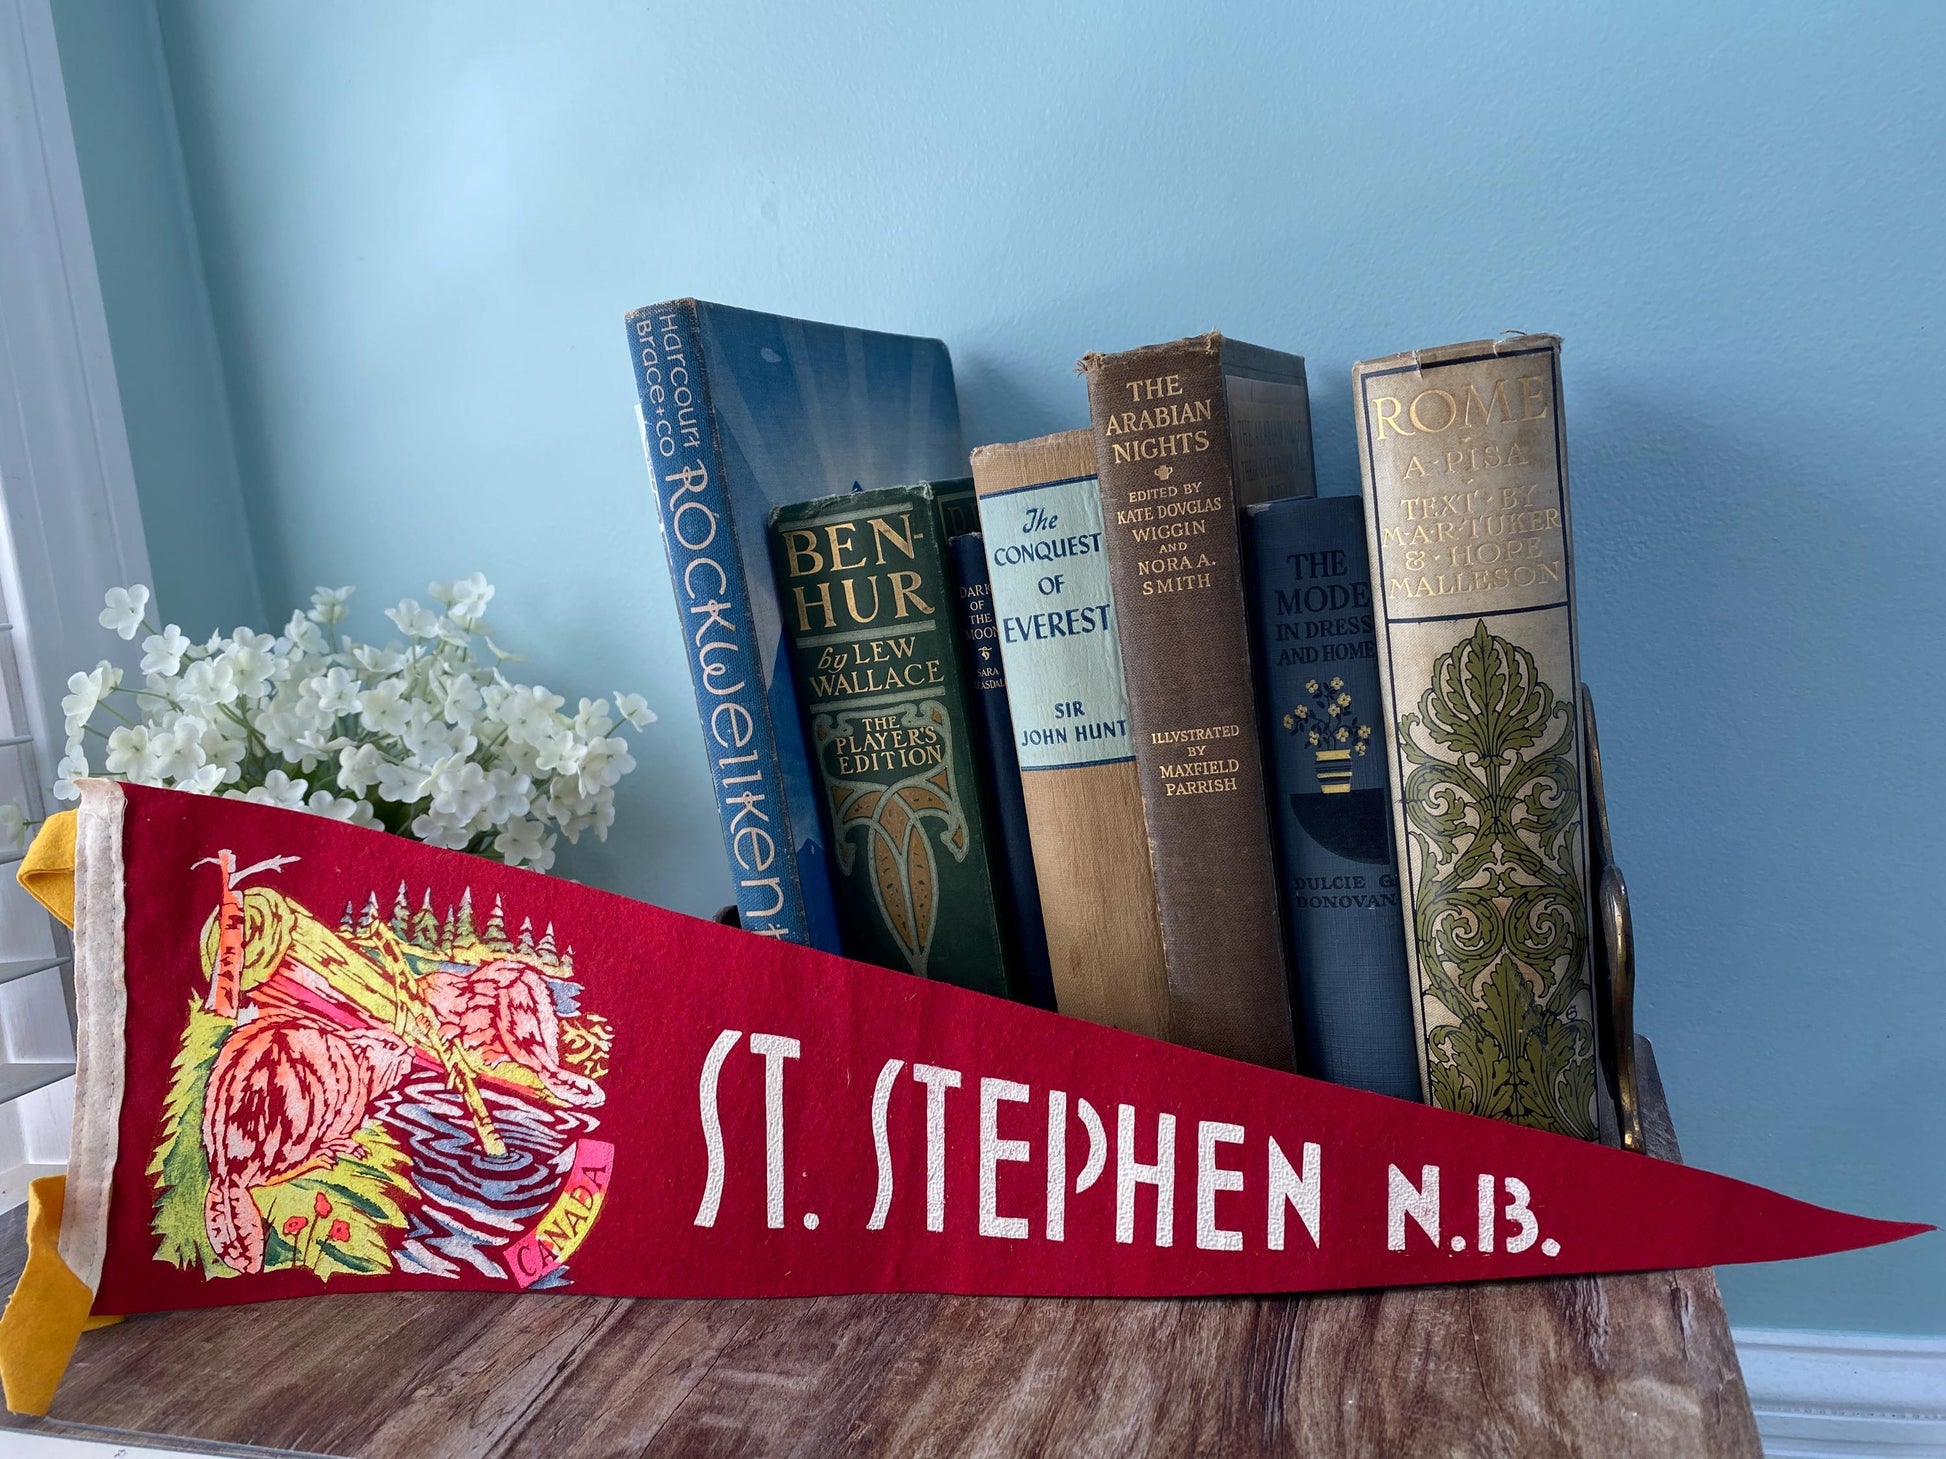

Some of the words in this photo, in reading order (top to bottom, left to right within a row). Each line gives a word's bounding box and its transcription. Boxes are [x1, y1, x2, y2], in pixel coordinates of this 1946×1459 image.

[658, 314, 701, 449] Harcourt
[1126, 375, 1183, 402] THE
[1106, 400, 1212, 436] ARABIAN
[1372, 375, 1548, 441] ROME
[1112, 430, 1210, 464] NIGHTS
[1446, 442, 1529, 474] PISA
[1129, 486, 1178, 503] EDITED
[1183, 481, 1202, 494] BY
[1401, 489, 1480, 521] TEXT
[1502, 484, 1539, 511] BY
[1023, 508, 1057, 534] The
[1116, 506, 1152, 525] KATE
[1132, 519, 1206, 543] WIGGIN
[993, 532, 1102, 567] CONQUEST
[1159, 541, 1188, 554] AND
[1405, 551, 1426, 571] &
[1450, 537, 1543, 569] HOPE
[1138, 557, 1193, 576] NORA
[1198, 553, 1216, 568] A.
[1287, 549, 1348, 581] THE
[1037, 575, 1065, 595] OF
[1142, 573, 1212, 595] SMITH
[1389, 560, 1561, 600] MALLESON
[793, 570, 936, 632] HUR
[970, 600, 985, 611] OF
[1275, 581, 1371, 617] MODE
[969, 613, 993, 624] THE
[1002, 604, 1111, 644] EVEREST
[1276, 624, 1301, 642] IN
[1304, 614, 1374, 639] DRESS
[817, 646, 848, 673] by
[853, 637, 916, 666] LEW
[1276, 648, 1318, 667] AND
[1322, 642, 1375, 662] HOME
[809, 660, 945, 699] WALLACE
[977, 668, 999, 678] SARA
[862, 715, 900, 733] THE
[1054, 701, 1086, 719] SIR
[834, 726, 938, 755] PLAYER'S
[1020, 727, 1068, 747] JOHN
[1074, 719, 1127, 740] HUNT
[838, 745, 944, 776] EDITION
[1187, 745, 1207, 757] BY
[1159, 759, 1240, 779] MAXFIELD
[1165, 777, 1237, 796] PARRISH
[1294, 874, 1367, 891] DULCIE
[1295, 892, 1398, 910] DONOVAN
[693, 1029, 821, 1233] ST.
[865, 1058, 1323, 1252] STEPHEN
[1387, 1161, 1562, 1258] N.B.
[517, 1165, 606, 1277] CANADA
